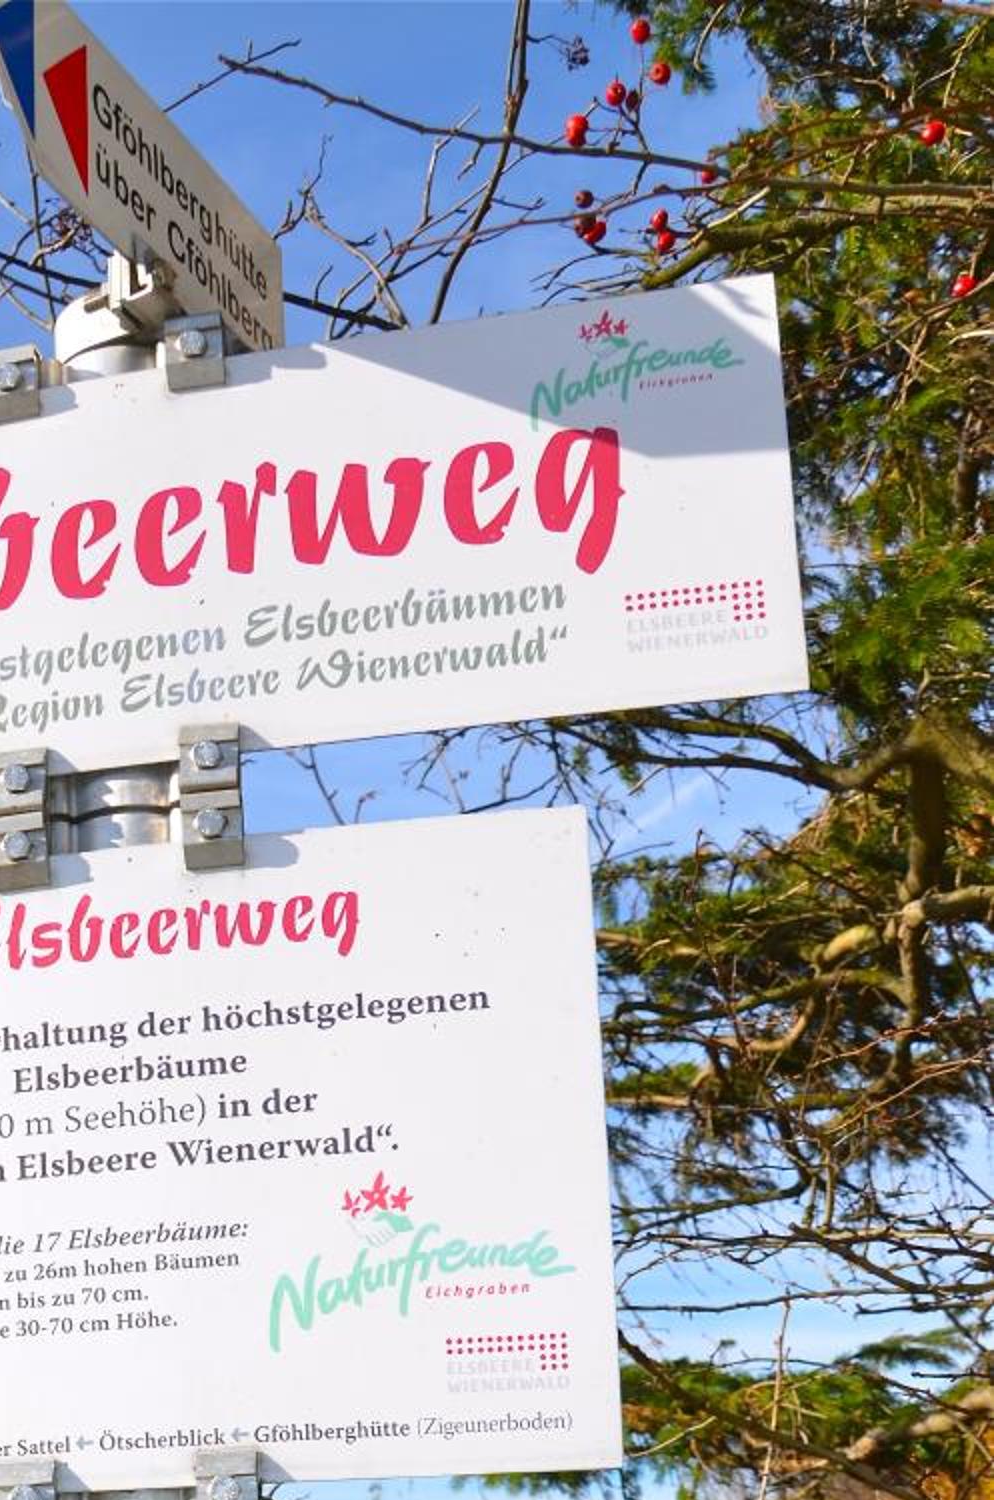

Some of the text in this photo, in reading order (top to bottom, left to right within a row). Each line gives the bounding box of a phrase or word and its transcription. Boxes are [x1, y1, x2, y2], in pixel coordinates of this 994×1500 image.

[92, 84, 268, 300] Gföhlberghütte
[95, 143, 157, 232] über
[530, 338, 745, 432] Naturfreunde
[244, 582, 566, 648] Elsbeerbäumen
[626, 610, 728, 634] ELSBEERE
[626, 625, 770, 655] WIENERWALD
[119, 667, 280, 713] Elsbeere
[137, 1011, 191, 1038] der
[202, 990, 492, 1031] höchstgelegenen
[13, 1052, 248, 1094] Elsbeerbäume
[25, 1115, 54, 1136] m
[64, 1093, 207, 1132] Seehöhe)
[217, 1093, 252, 1119] in
[261, 1087, 319, 1116] der
[16, 1148, 158, 1181] Elsbeere
[32, 1230, 63, 1254] 17
[66, 1221, 250, 1251] Elsbeerbäume:
[4, 1266, 28, 1284] zu
[32, 1261, 78, 1282] 26m
[83, 1256, 148, 1278] hohen
[154, 1250, 241, 1272] Bäumen
[16, 1290, 47, 1310] bis
[51, 1291, 77, 1307] zu
[80, 1286, 107, 1305] 70
[110, 1285, 150, 1304] cm.
[269, 1221, 577, 1353] Naturfreunde
[425, 1281, 531, 1300] Eichgraben
[15, 1316, 74, 1339] 30-70
[78, 1315, 111, 1332] cm
[116, 1308, 179, 1331] Höhe.
[446, 1358, 536, 1377] ELSBEERE
[446, 1374, 571, 1394] WIENERWALD
[16, 1436, 72, 1456] Sattel
[99, 1426, 227, 1452] Ötscherblick
[253, 1418, 411, 1444] Gföhlberghütte
[416, 1412, 574, 1438] (Zigeunerboden)
